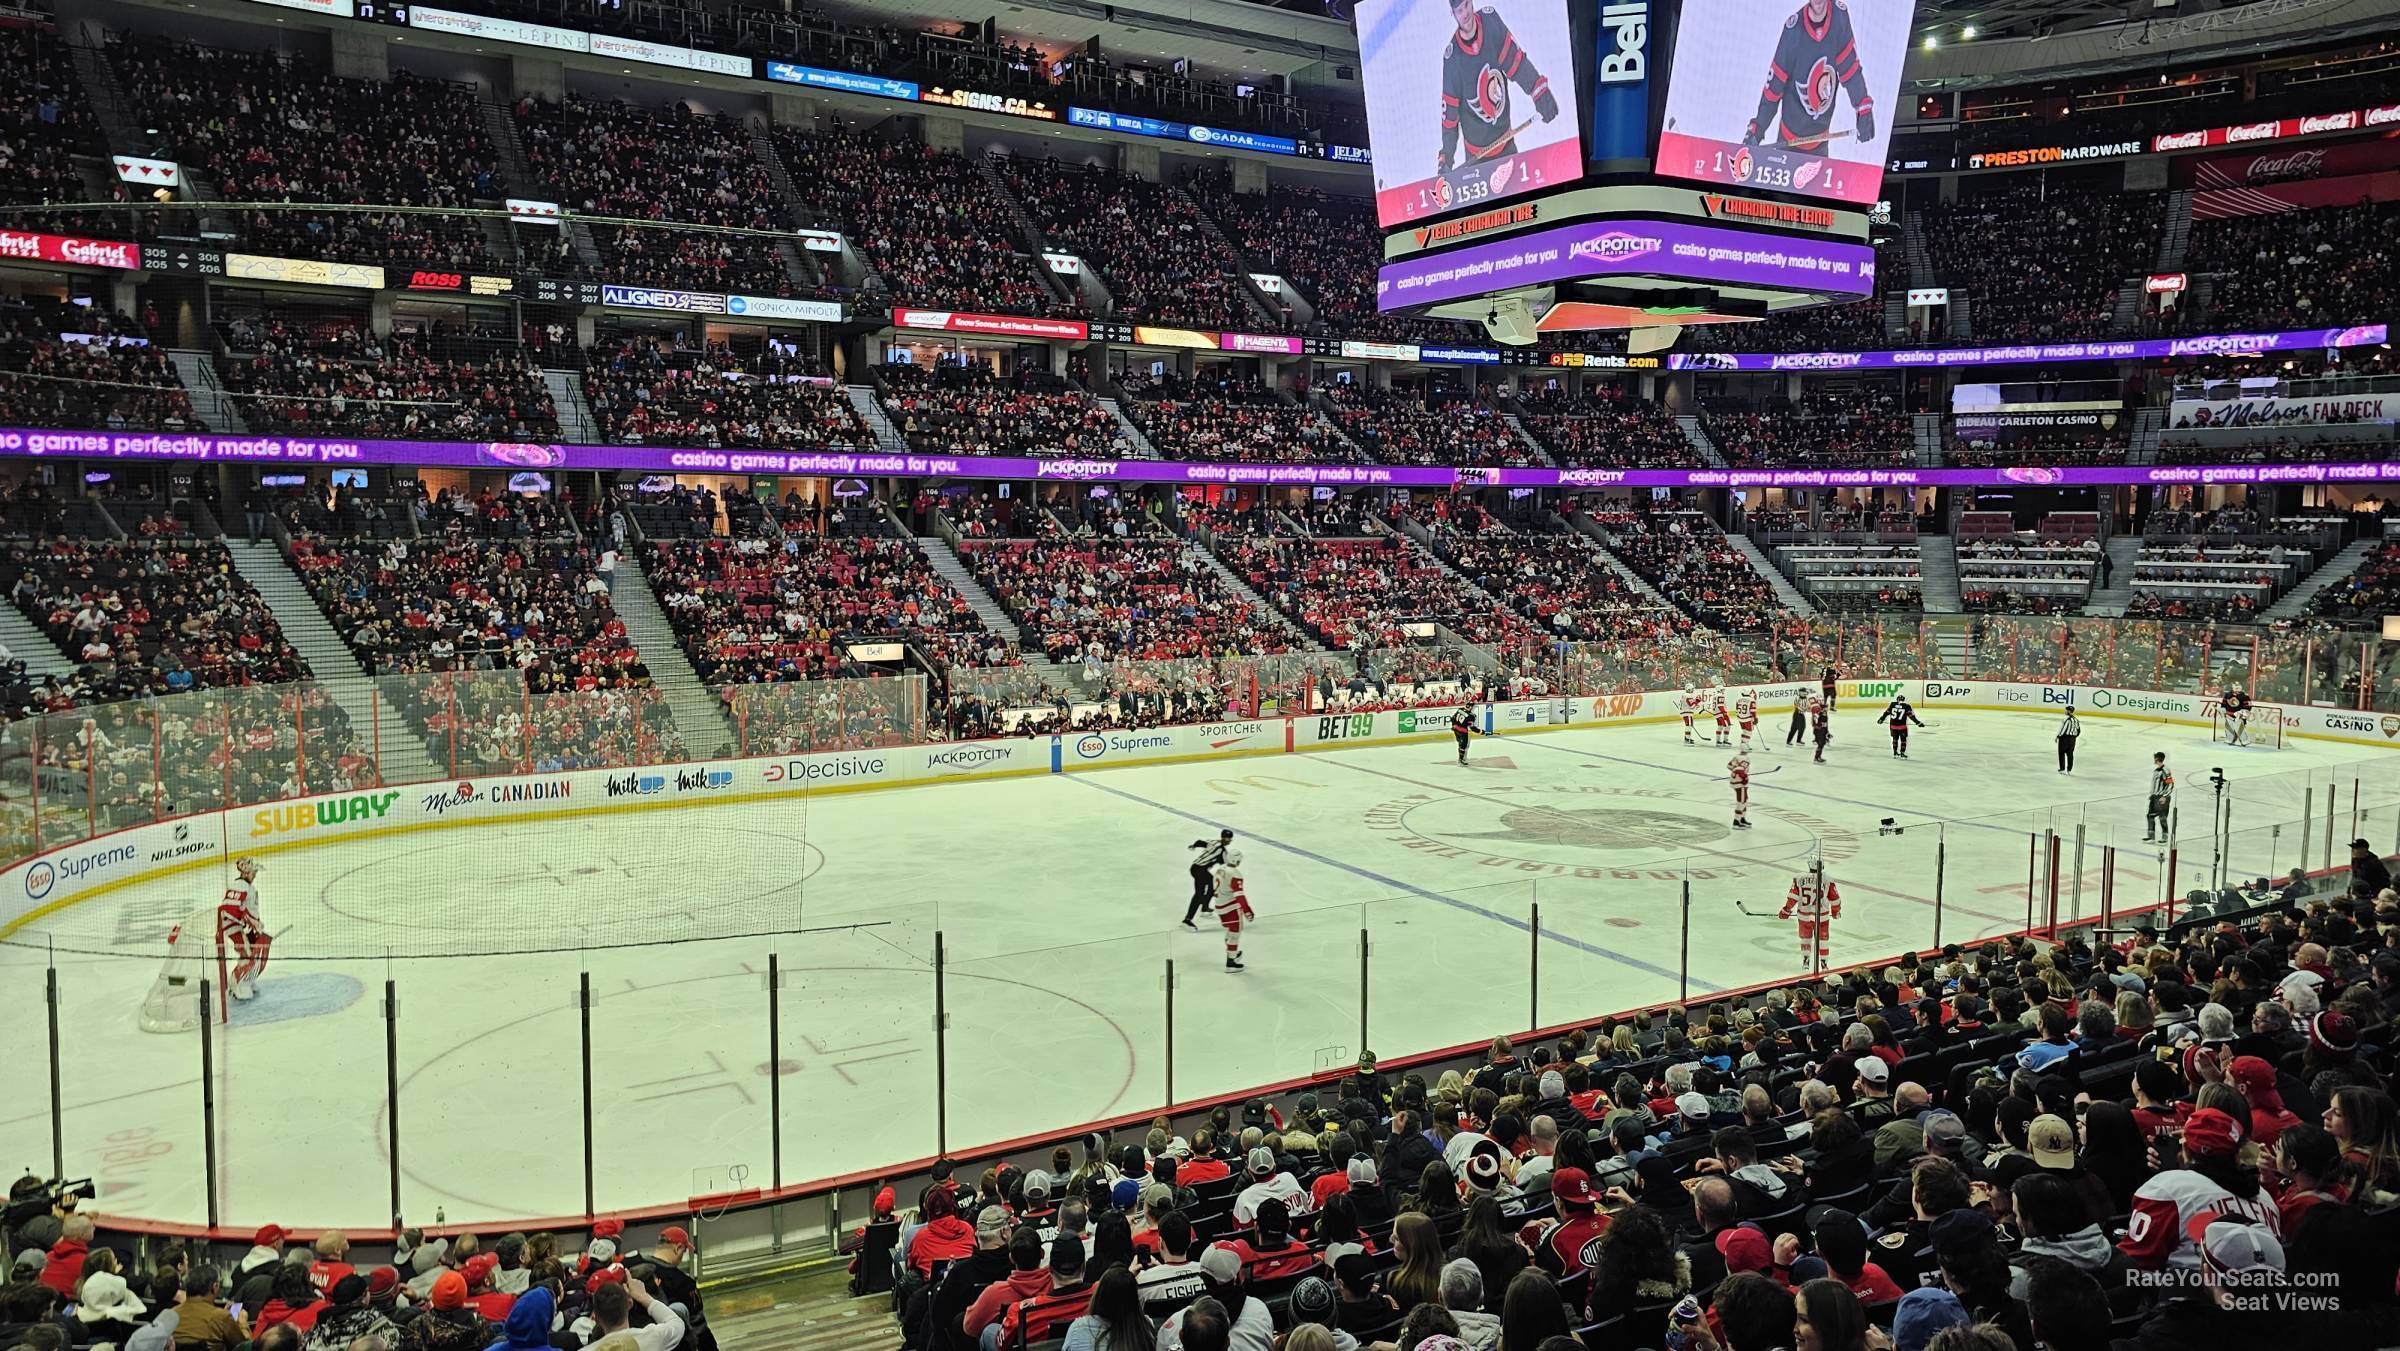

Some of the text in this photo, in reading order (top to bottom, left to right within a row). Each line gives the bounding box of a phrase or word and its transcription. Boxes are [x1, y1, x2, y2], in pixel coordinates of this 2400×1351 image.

[1601, 2, 1647, 83] Bell
[951, 90, 1027, 115] SIGNS.CA
[2229, 123, 2275, 141] Coca-Cola
[2303, 114, 2350, 133] Coca-Cola
[1211, 131, 1254, 146] GADAR
[2159, 132, 2202, 150] Coca-Cola
[1712, 151, 1722, 172] 1
[2247, 150, 2328, 176] Coca-Cola
[1519, 162, 1529, 182] 1
[1535, 169, 1541, 178] 9
[1755, 166, 1790, 187] 15:33
[1823, 168, 1832, 188] 1
[1456, 180, 1488, 204] 15:33
[1836, 180, 1842, 190] 9
[1419, 190, 1428, 208] 1
[1725, 199, 1835, 227] CANADIAN TIRE CENTRE
[1431, 205, 1534, 241] CENTRE CANADIAN TIRE
[61, 239, 126, 259] Gabriel
[145, 248, 167, 258] 305
[1569, 236, 1662, 260] JACKPOTCITY
[145, 260, 168, 269] 205
[198, 253, 220, 262] 306
[1673, 243, 1850, 275] casino games perfectly made for you
[199, 264, 221, 274] 206
[1397, 248, 1558, 289] casino games perfectly made for you
[411, 271, 463, 287] ROSS
[538, 281, 556, 290] 306
[538, 291, 557, 300] 206
[580, 284, 598, 293] 307
[605, 288, 677, 307] ALIGNED
[581, 294, 598, 303] 207
[750, 301, 841, 317] KONICA MINOLTA
[955, 317, 976, 327] Know
[975, 319, 1000, 329] Sooner.
[1000, 321, 1012, 330] Act
[1119, 326, 1131, 334] 309
[1244, 337, 1289, 348] MAGENTA
[2169, 335, 2278, 356] JACKPOTCITY
[1422, 348, 1499, 361] www.capitalsecurity.ca
[1772, 353, 1861, 369] JACKPOTCITY
[1893, 343, 2134, 363] casino games perfectly made for you
[2313, 402, 2339, 421] FAN
[2345, 400, 2383, 419] DECK
[1955, 414, 2098, 427] RIDEAU CARLETON CASINO
[27, 434, 109, 455] games
[114, 436, 211, 458] perfectly
[217, 438, 281, 456] made
[287, 440, 316, 457] for
[672, 451, 959, 473] casino games perfectly made for you.
[1037, 461, 1118, 477] JACKPOTCITY
[173, 476, 191, 484] 103
[1187, 466, 1392, 483] casino games perfectly made for you.
[1558, 470, 1625, 484] JACKPOTCITY
[1688, 472, 1728, 483] casino
[1730, 472, 1772, 485] games
[1774, 471, 1827, 485] perfectly
[1829, 471, 1869, 483] made
[1871, 471, 1889, 483] for
[2150, 464, 2377, 482] casino games perfectly made
[618, 483, 634, 491] 105
[926, 488, 939, 496] 106
[866, 646, 883, 656] Bell
[1997, 687, 2029, 702] Fibe
[2042, 687, 2075, 705] Bell
[2116, 693, 2190, 713] Desjardins
[1607, 694, 1643, 718] SKIP
[1736, 704, 1748, 714] 59
[1890, 708, 1906, 720] 57
[1317, 713, 1374, 740] BET99
[2325, 718, 2374, 732] CASINO
[1081, 734, 1170, 753] Esso Supreme
[927, 747, 1012, 769] JACKPOTCITY
[788, 755, 885, 781] Decisive
[421, 780, 571, 814] Molson CANADIAN
[250, 790, 400, 839] SUBWAY
[151, 842, 215, 863] NHLSHOP.CA
[1384, 835, 1471, 860] TIRE
[30, 845, 136, 890] Esso Supreme
[1476, 857, 1750, 883] CANADIAN
[1801, 887, 1825, 907] 52
